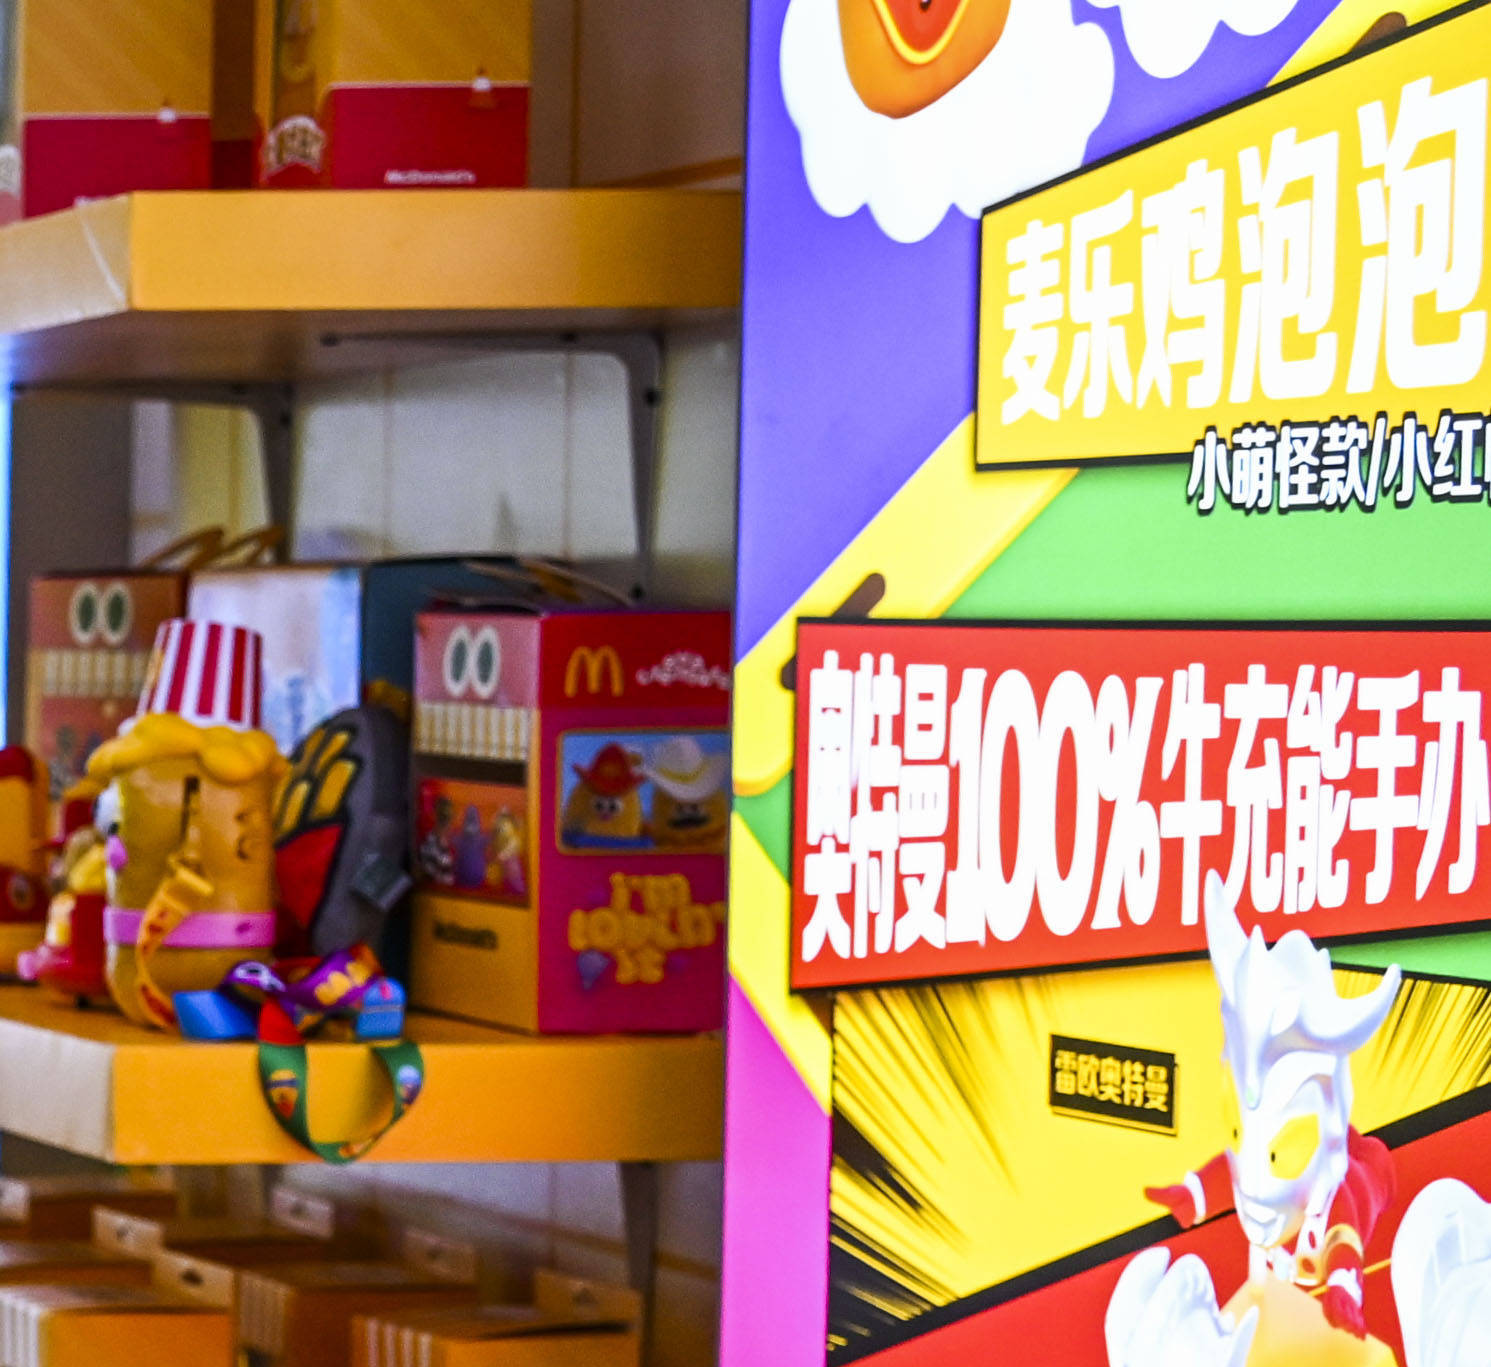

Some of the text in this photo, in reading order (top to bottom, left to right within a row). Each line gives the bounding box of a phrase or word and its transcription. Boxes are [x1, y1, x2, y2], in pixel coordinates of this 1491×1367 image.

[1001, 74, 1491, 427] 麦乐鸡泡泡
[1186, 416, 1491, 510] 小萌怪款/小红
[1054, 1049, 1169, 1112] 雷欧奥特曼
